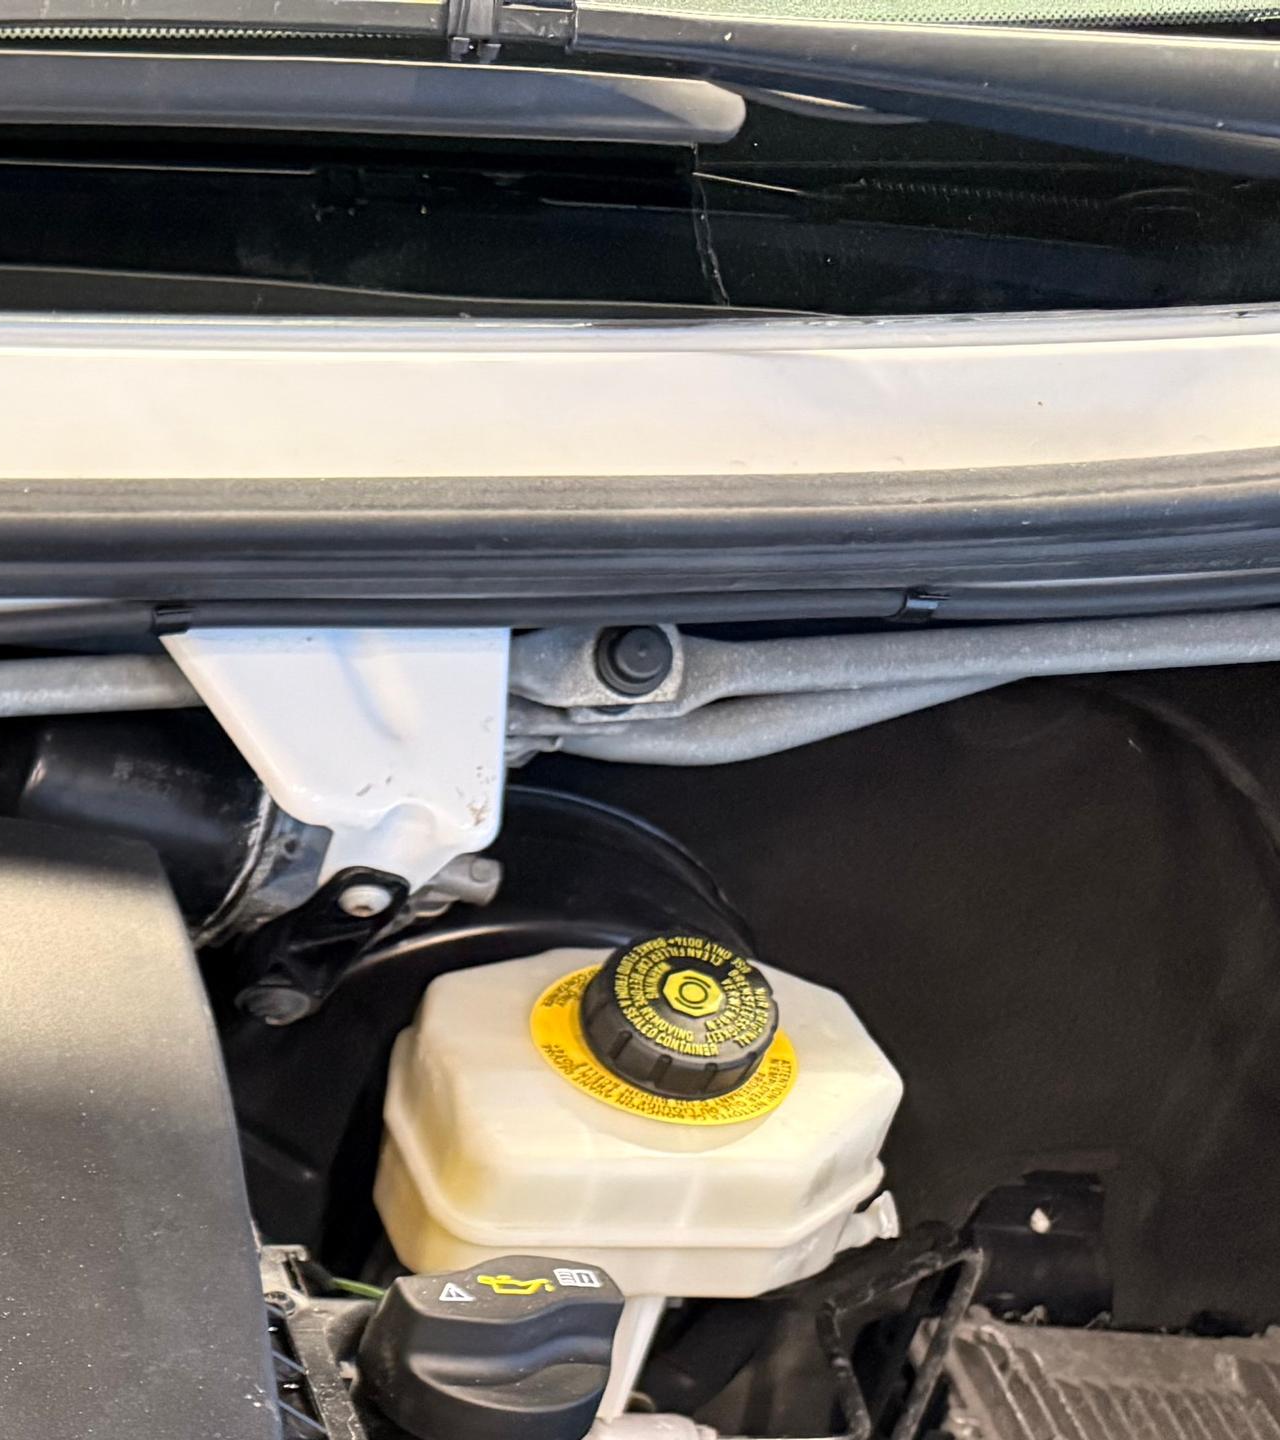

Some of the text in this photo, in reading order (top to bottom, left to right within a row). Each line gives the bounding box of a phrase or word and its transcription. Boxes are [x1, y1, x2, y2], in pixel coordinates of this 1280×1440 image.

[703, 942, 734, 961] ONLY
[622, 1006, 659, 1038] SEALED
[639, 1006, 695, 1042] REMOVING
[655, 1032, 720, 1057] CONTAINER
